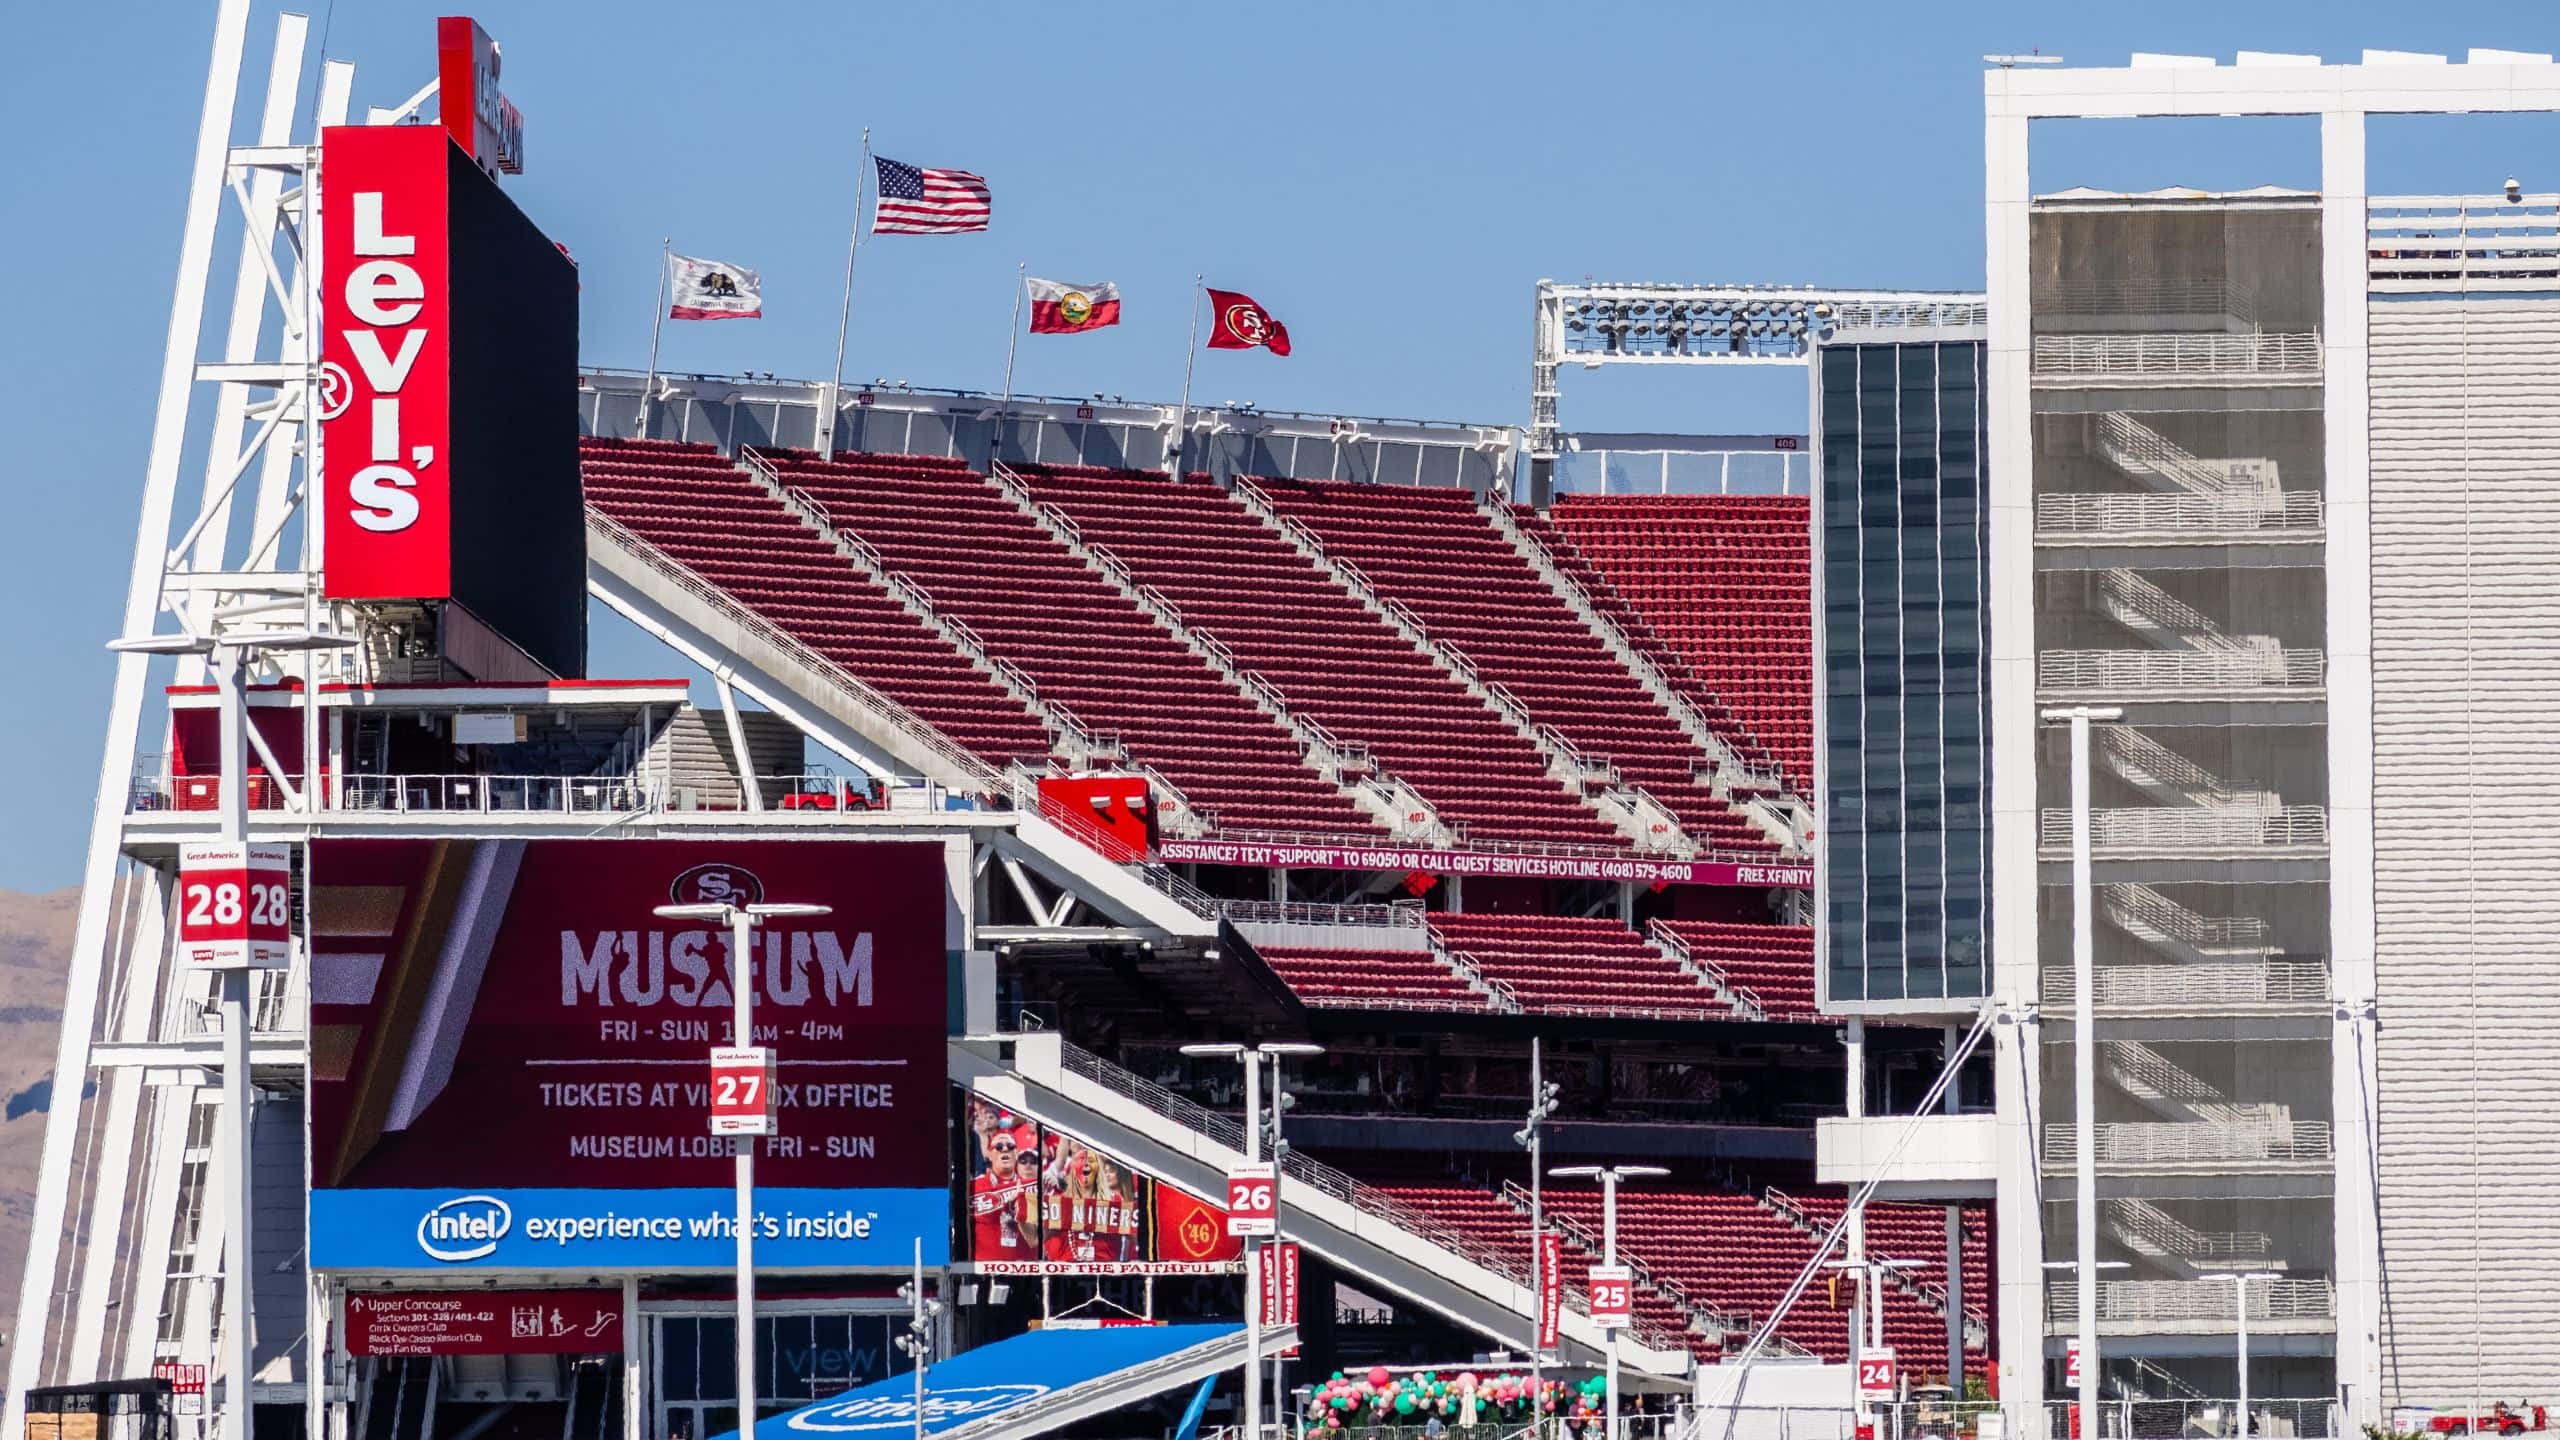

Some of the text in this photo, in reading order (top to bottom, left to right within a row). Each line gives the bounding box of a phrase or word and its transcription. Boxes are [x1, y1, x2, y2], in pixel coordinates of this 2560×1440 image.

[1158, 801, 1176, 812] 402
[1408, 812, 1425, 823] 403
[1160, 844, 1238, 862] ASSISTANCE?
[1241, 847, 1271, 863] TEXT
[1342, 851, 1359, 866] TO
[1362, 852, 1400, 868] 69050
[1402, 854, 1419, 869] OR
[1421, 855, 1451, 870] CALL
[1453, 856, 1492, 872] GUEST
[1493, 857, 1548, 874] SERVICES
[1550, 861, 1600, 877] HOTLINE
[1602, 862, 1634, 878] (408)
[1635, 864, 1692, 880] 579-4600
[1736, 867, 1813, 885] FREE XFINITY
[187, 883, 242, 926] 28
[251, 884, 287, 926] 28
[600, 1020, 637, 1041] FRI
[660, 1020, 709, 1041] SUN
[721, 1020, 778, 1041] 1AM
[801, 1020, 843, 1041] 4PM
[540, 1083, 642, 1106] TICKETS
[650, 1083, 679, 1106] AT
[684, 1083, 712, 1106] VI
[806, 1084, 894, 1107] OFFICE
[717, 1076, 760, 1105] 27
[570, 1136, 674, 1158] MUSEUM
[680, 1136, 737, 1158] LOBB
[767, 1136, 802, 1158] FRI
[826, 1136, 875, 1158] SUN
[1233, 1185, 1271, 1211] 26
[430, 1210, 496, 1239] intel
[526, 1211, 681, 1245] experience
[984, 1263, 1216, 1273] HOME OF THE FAITHFUL
[368, 1299, 461, 1312] Upper Concourse
[1593, 1286, 1625, 1308] 25
[377, 1314, 410, 1322] Sections
[2070, 1355, 2080, 1371] 2
[1863, 1365, 1891, 1384] 24
